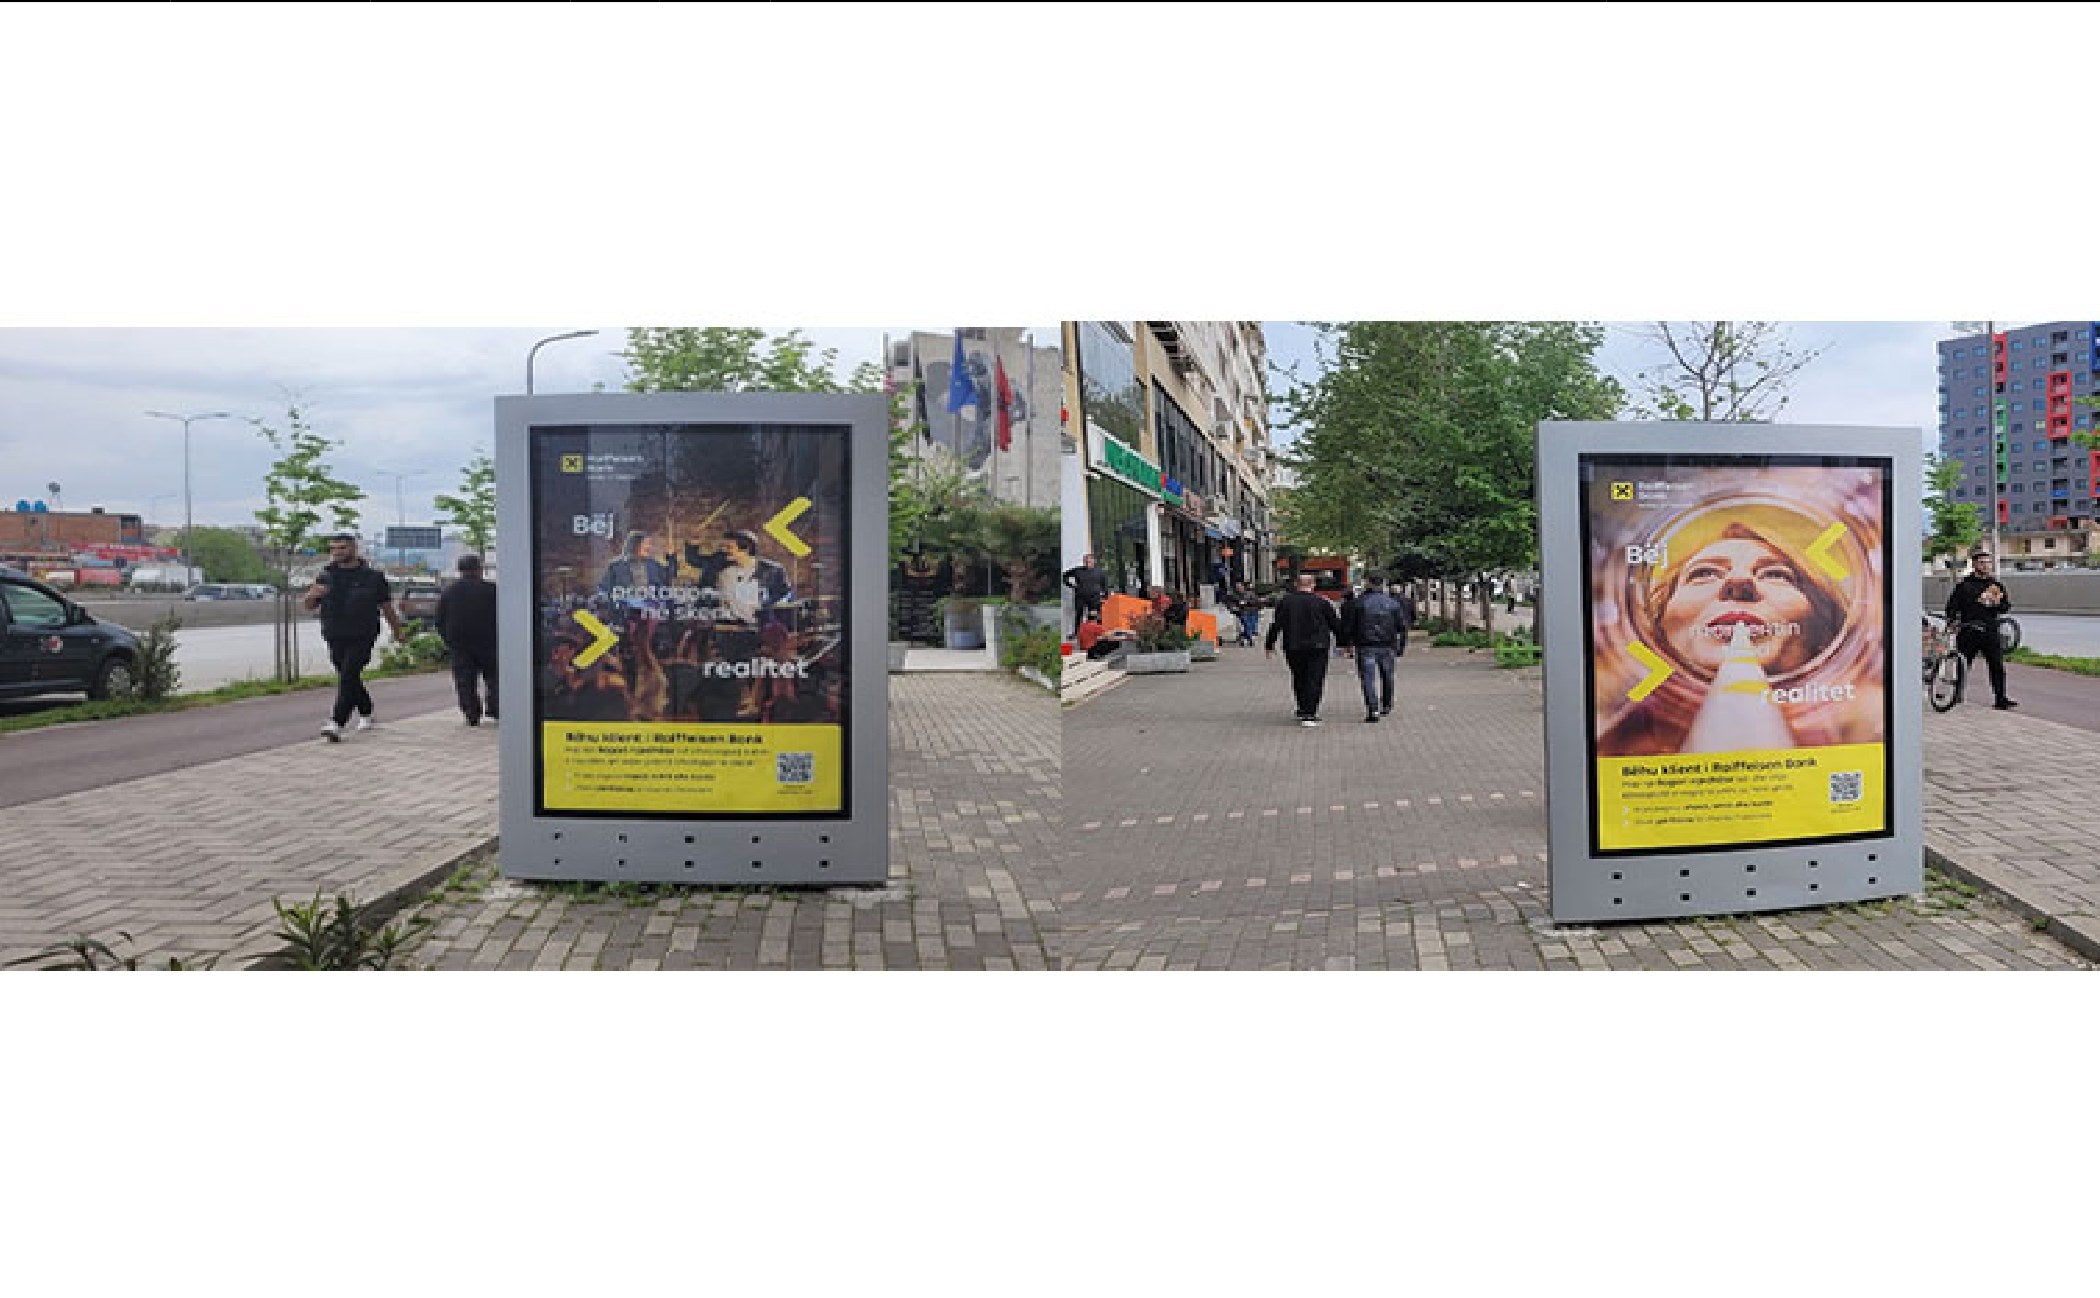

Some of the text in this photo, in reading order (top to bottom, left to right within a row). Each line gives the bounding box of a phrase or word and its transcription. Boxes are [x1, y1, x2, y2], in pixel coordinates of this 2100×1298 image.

[572, 511, 614, 540] Bëj
[1625, 541, 1668, 569] Bëj
[704, 656, 809, 679] realitet
[1759, 683, 1858, 704] realitet
